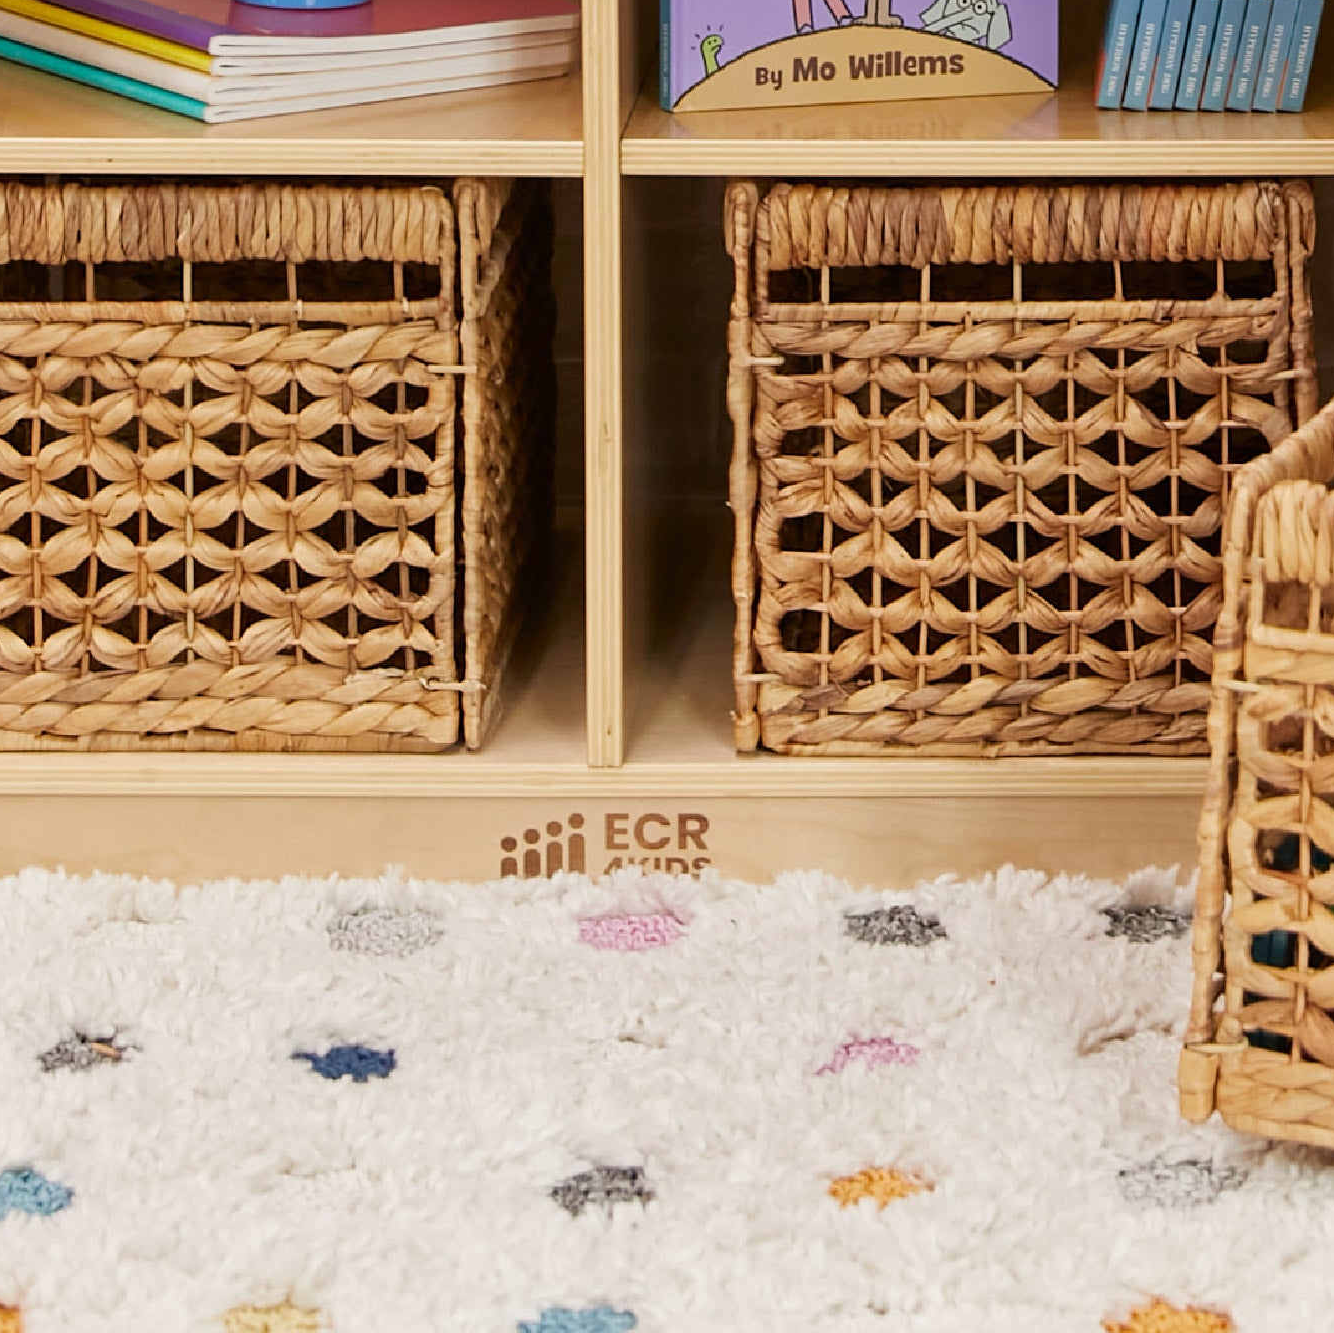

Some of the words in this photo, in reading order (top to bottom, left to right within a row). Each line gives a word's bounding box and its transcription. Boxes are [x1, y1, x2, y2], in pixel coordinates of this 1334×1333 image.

[755, 66, 783, 90] By
[792, 56, 836, 83] Mo
[849, 50, 965, 78] Willems
[604, 813, 710, 850] ECR
